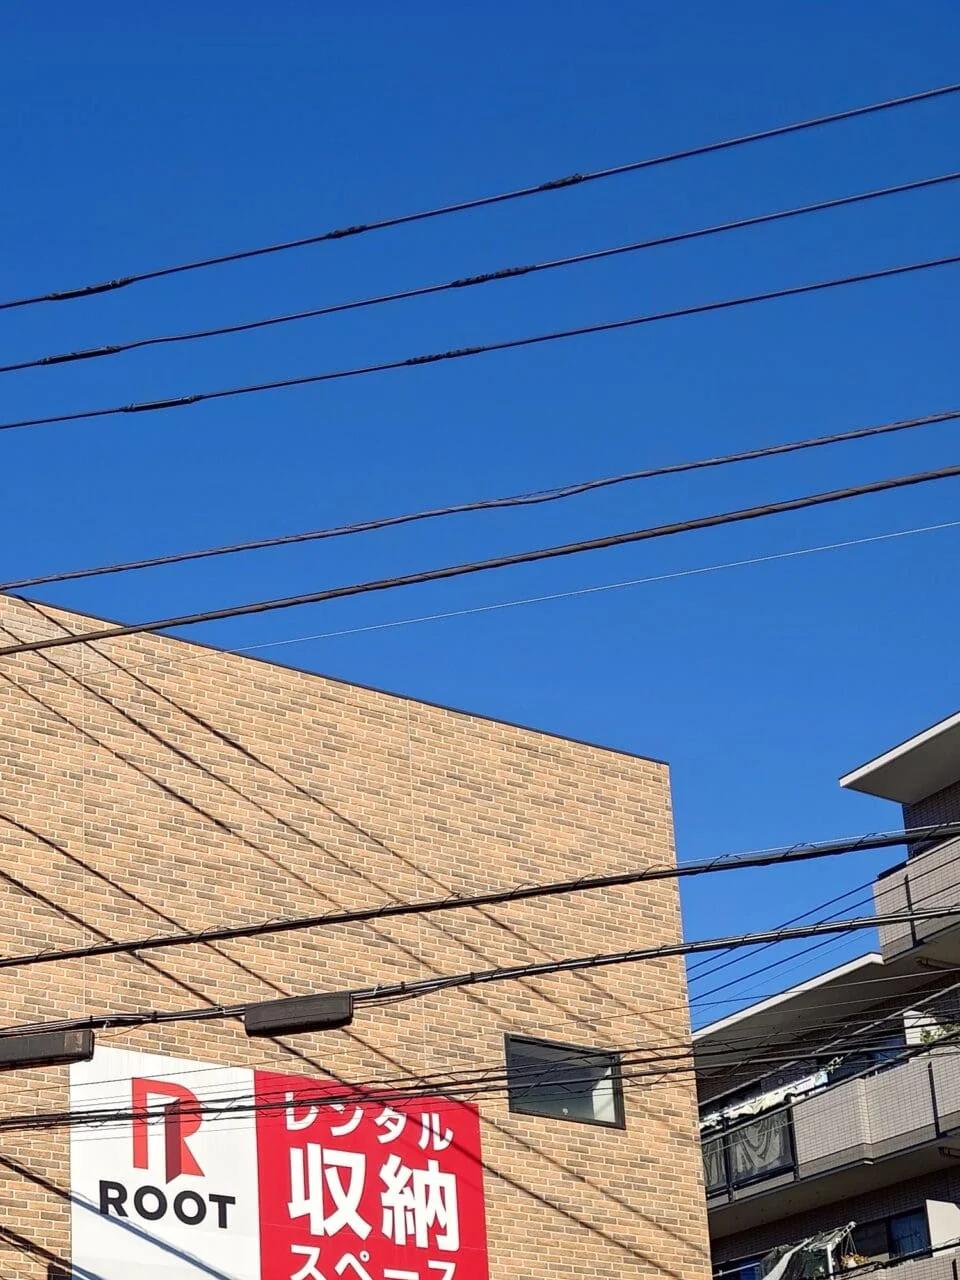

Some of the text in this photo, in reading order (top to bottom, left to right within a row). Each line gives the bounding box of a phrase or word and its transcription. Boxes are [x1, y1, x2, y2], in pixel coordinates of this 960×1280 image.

[285, 1091, 454, 1151] レンタル
[99, 1180, 236, 1229] ROOT
[288, 1143, 460, 1252] 収納
